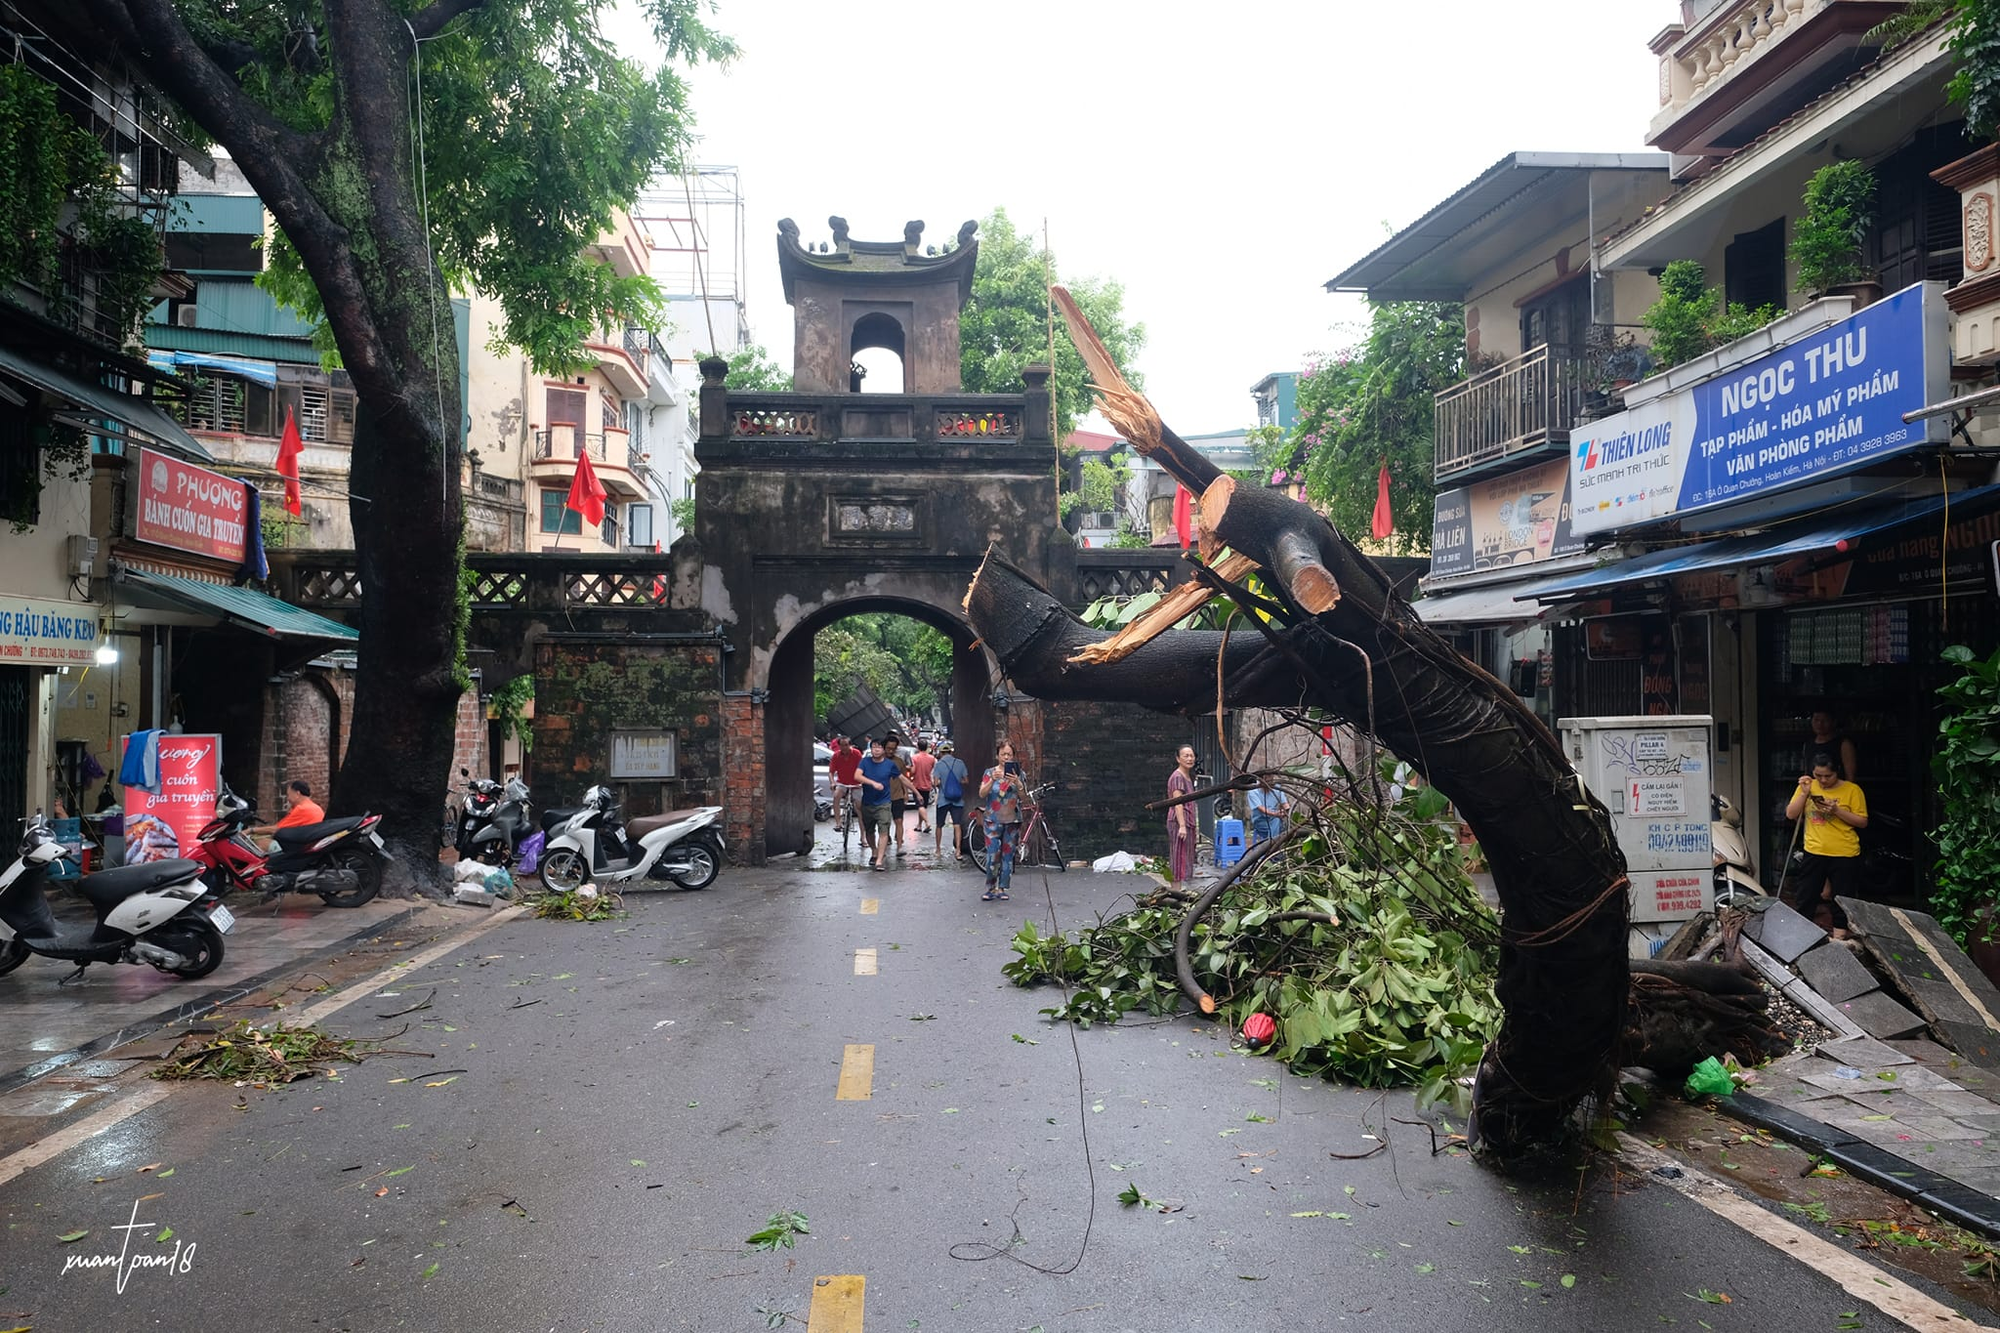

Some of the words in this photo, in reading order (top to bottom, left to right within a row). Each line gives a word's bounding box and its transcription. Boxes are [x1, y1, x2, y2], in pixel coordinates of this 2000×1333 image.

[1722, 360, 1794, 418] NGỌC
[1805, 327, 1866, 384] THU
[1701, 435, 1724, 460] TẠP
[1728, 418, 1768, 449] PHẨM
[1781, 403, 1812, 431] HÓA
[1817, 388, 1842, 418] MỸ
[1848, 368, 1898, 406] PHẨM
[1602, 430, 1636, 465] THIÊN
[1637, 421, 1672, 455] LONG
[1727, 453, 1755, 476] VĂN
[1760, 435, 1810, 467] PHÒNG
[1815, 414, 1863, 448] PHẨM
[1848, 444, 1859, 457] 04
[1860, 436, 1882, 453] 3928
[1884, 428, 1907, 446] 3963
[1580, 474, 1596, 490] SỨC
[1627, 464, 1641, 476] TRI
[1644, 453, 1669, 470] THỨC
[177, 472, 242, 511] PHƯỢNG
[144, 494, 171, 528] BÁNH
[172, 500, 196, 533] CUỐN
[197, 514, 212, 538] GIA
[1434, 528, 1445, 550] HÀ
[1447, 526, 1466, 548] LIÊN
[14, 606, 39, 642] HẬU
[42, 610, 72, 639] BĂNG
[74, 618, 95, 641] KEO
[167, 770, 198, 785] cuốn
[1641, 781, 1654, 790] CẤM
[1656, 784, 1665, 792] LẠI
[146, 794, 168, 808] gia
[172, 789, 216, 807] truyền
